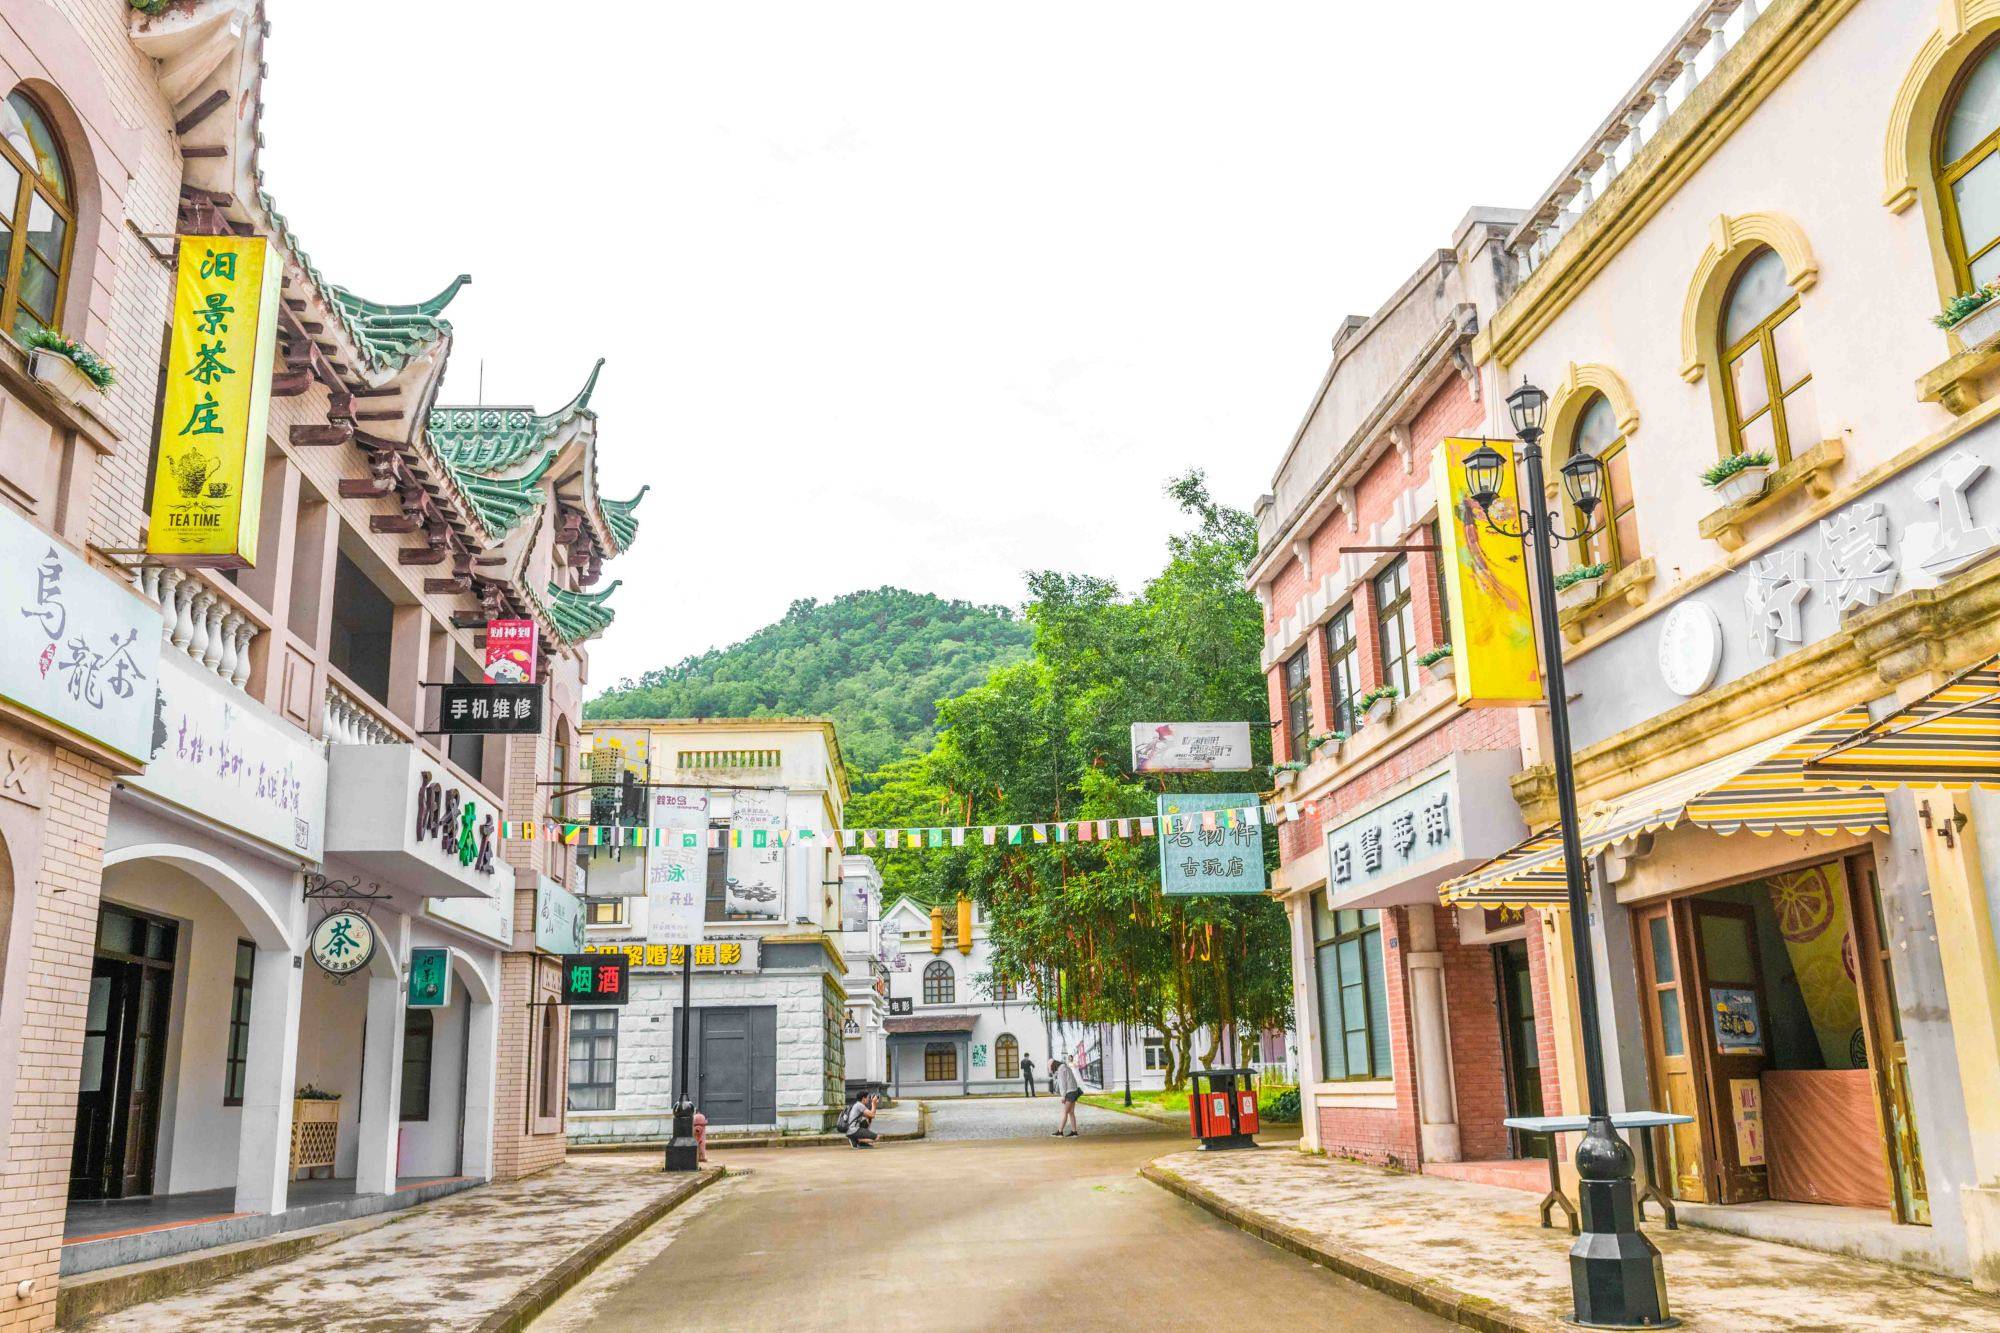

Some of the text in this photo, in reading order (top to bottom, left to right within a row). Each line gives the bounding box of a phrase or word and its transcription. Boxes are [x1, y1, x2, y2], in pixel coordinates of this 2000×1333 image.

[169, 514, 221, 527] TEA TIME
[450, 698, 531, 719] 手机维修
[1168, 818, 1258, 848] 老物件
[1180, 857, 1244, 877] 古玩店
[322, 918, 361, 958] 茶
[570, 965, 620, 993] 烟酒
[892, 1001, 910, 1012] 电影
